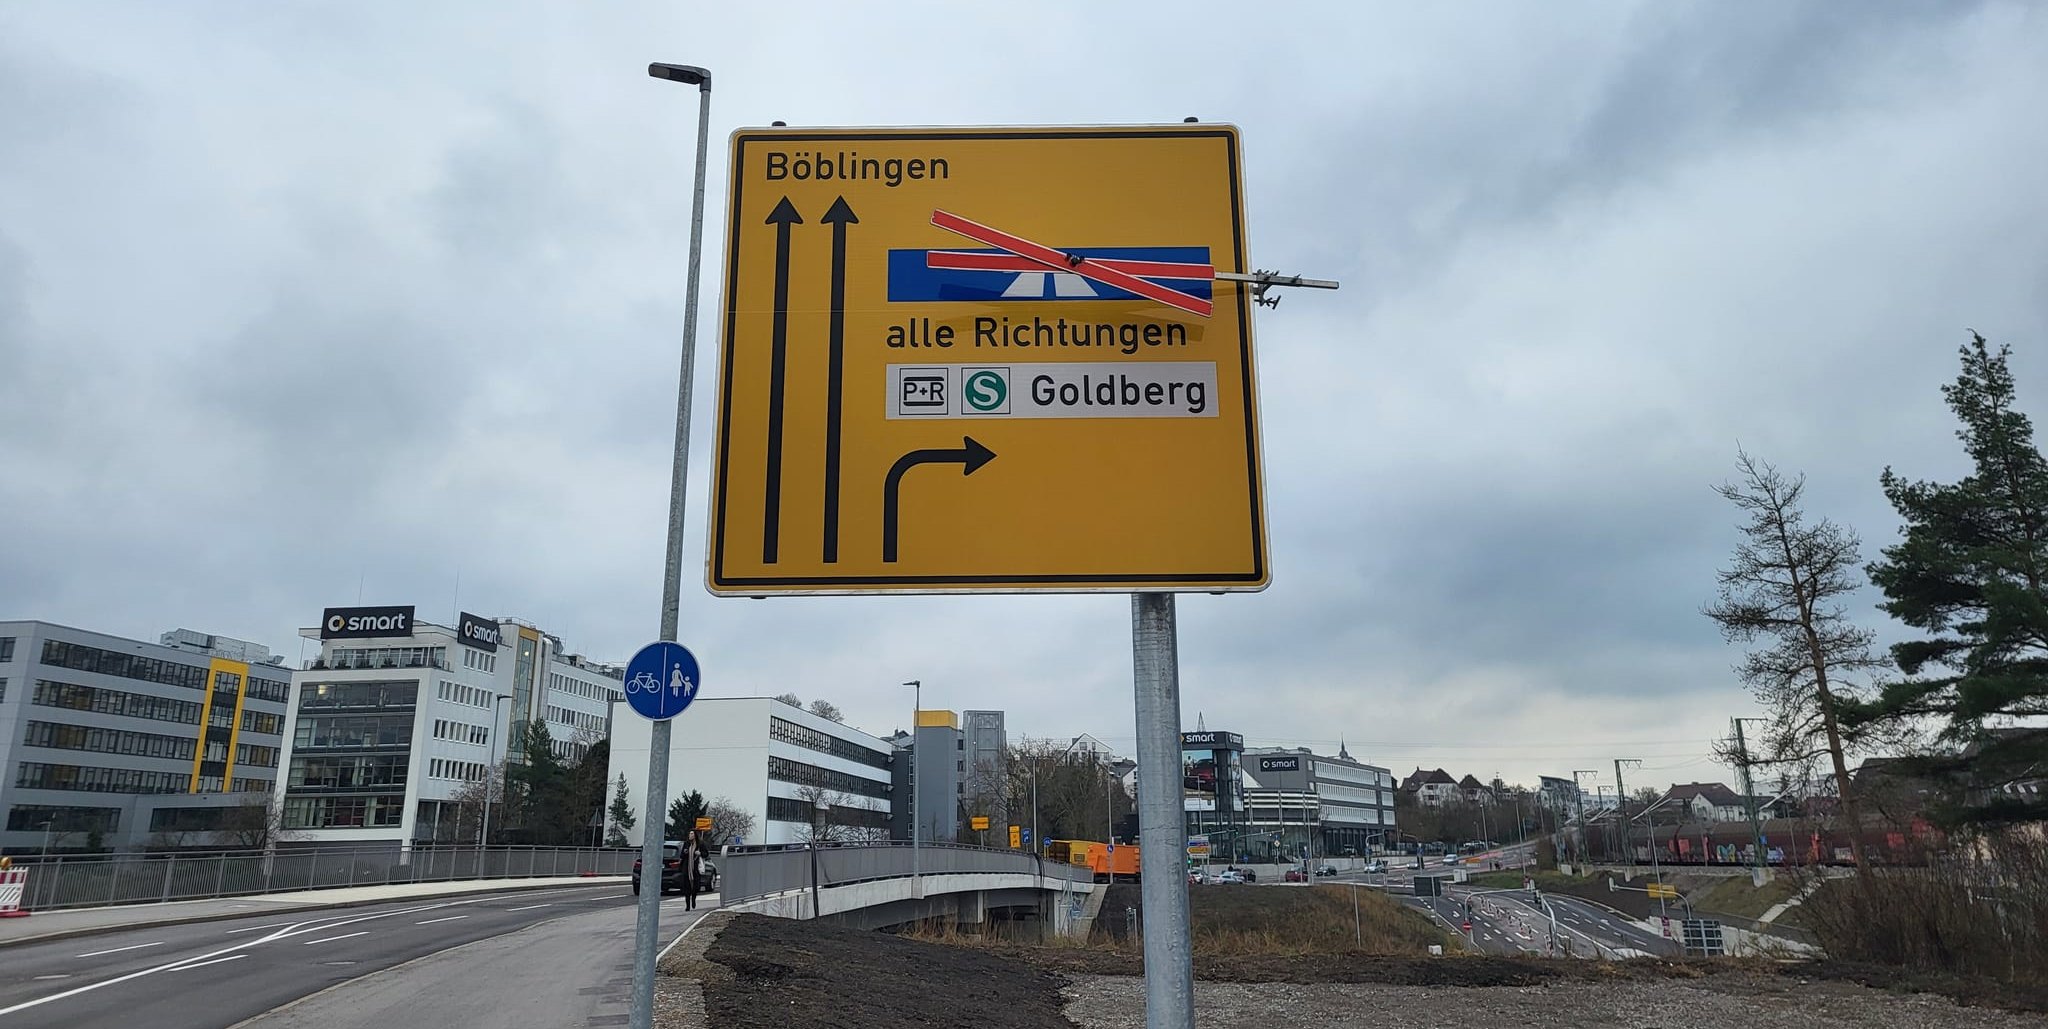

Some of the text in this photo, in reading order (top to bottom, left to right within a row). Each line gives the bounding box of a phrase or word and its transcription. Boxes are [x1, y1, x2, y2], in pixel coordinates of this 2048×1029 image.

[766, 152, 949, 187] Böblingen
[886, 317, 1187, 354] alle Richtungen
[903, 374, 1206, 413] P+R S Goldberg
[347, 613, 406, 631] smart
[472, 626, 498, 645] smart
[1185, 732, 1216, 743] smart
[1271, 760, 1296, 768] smart
